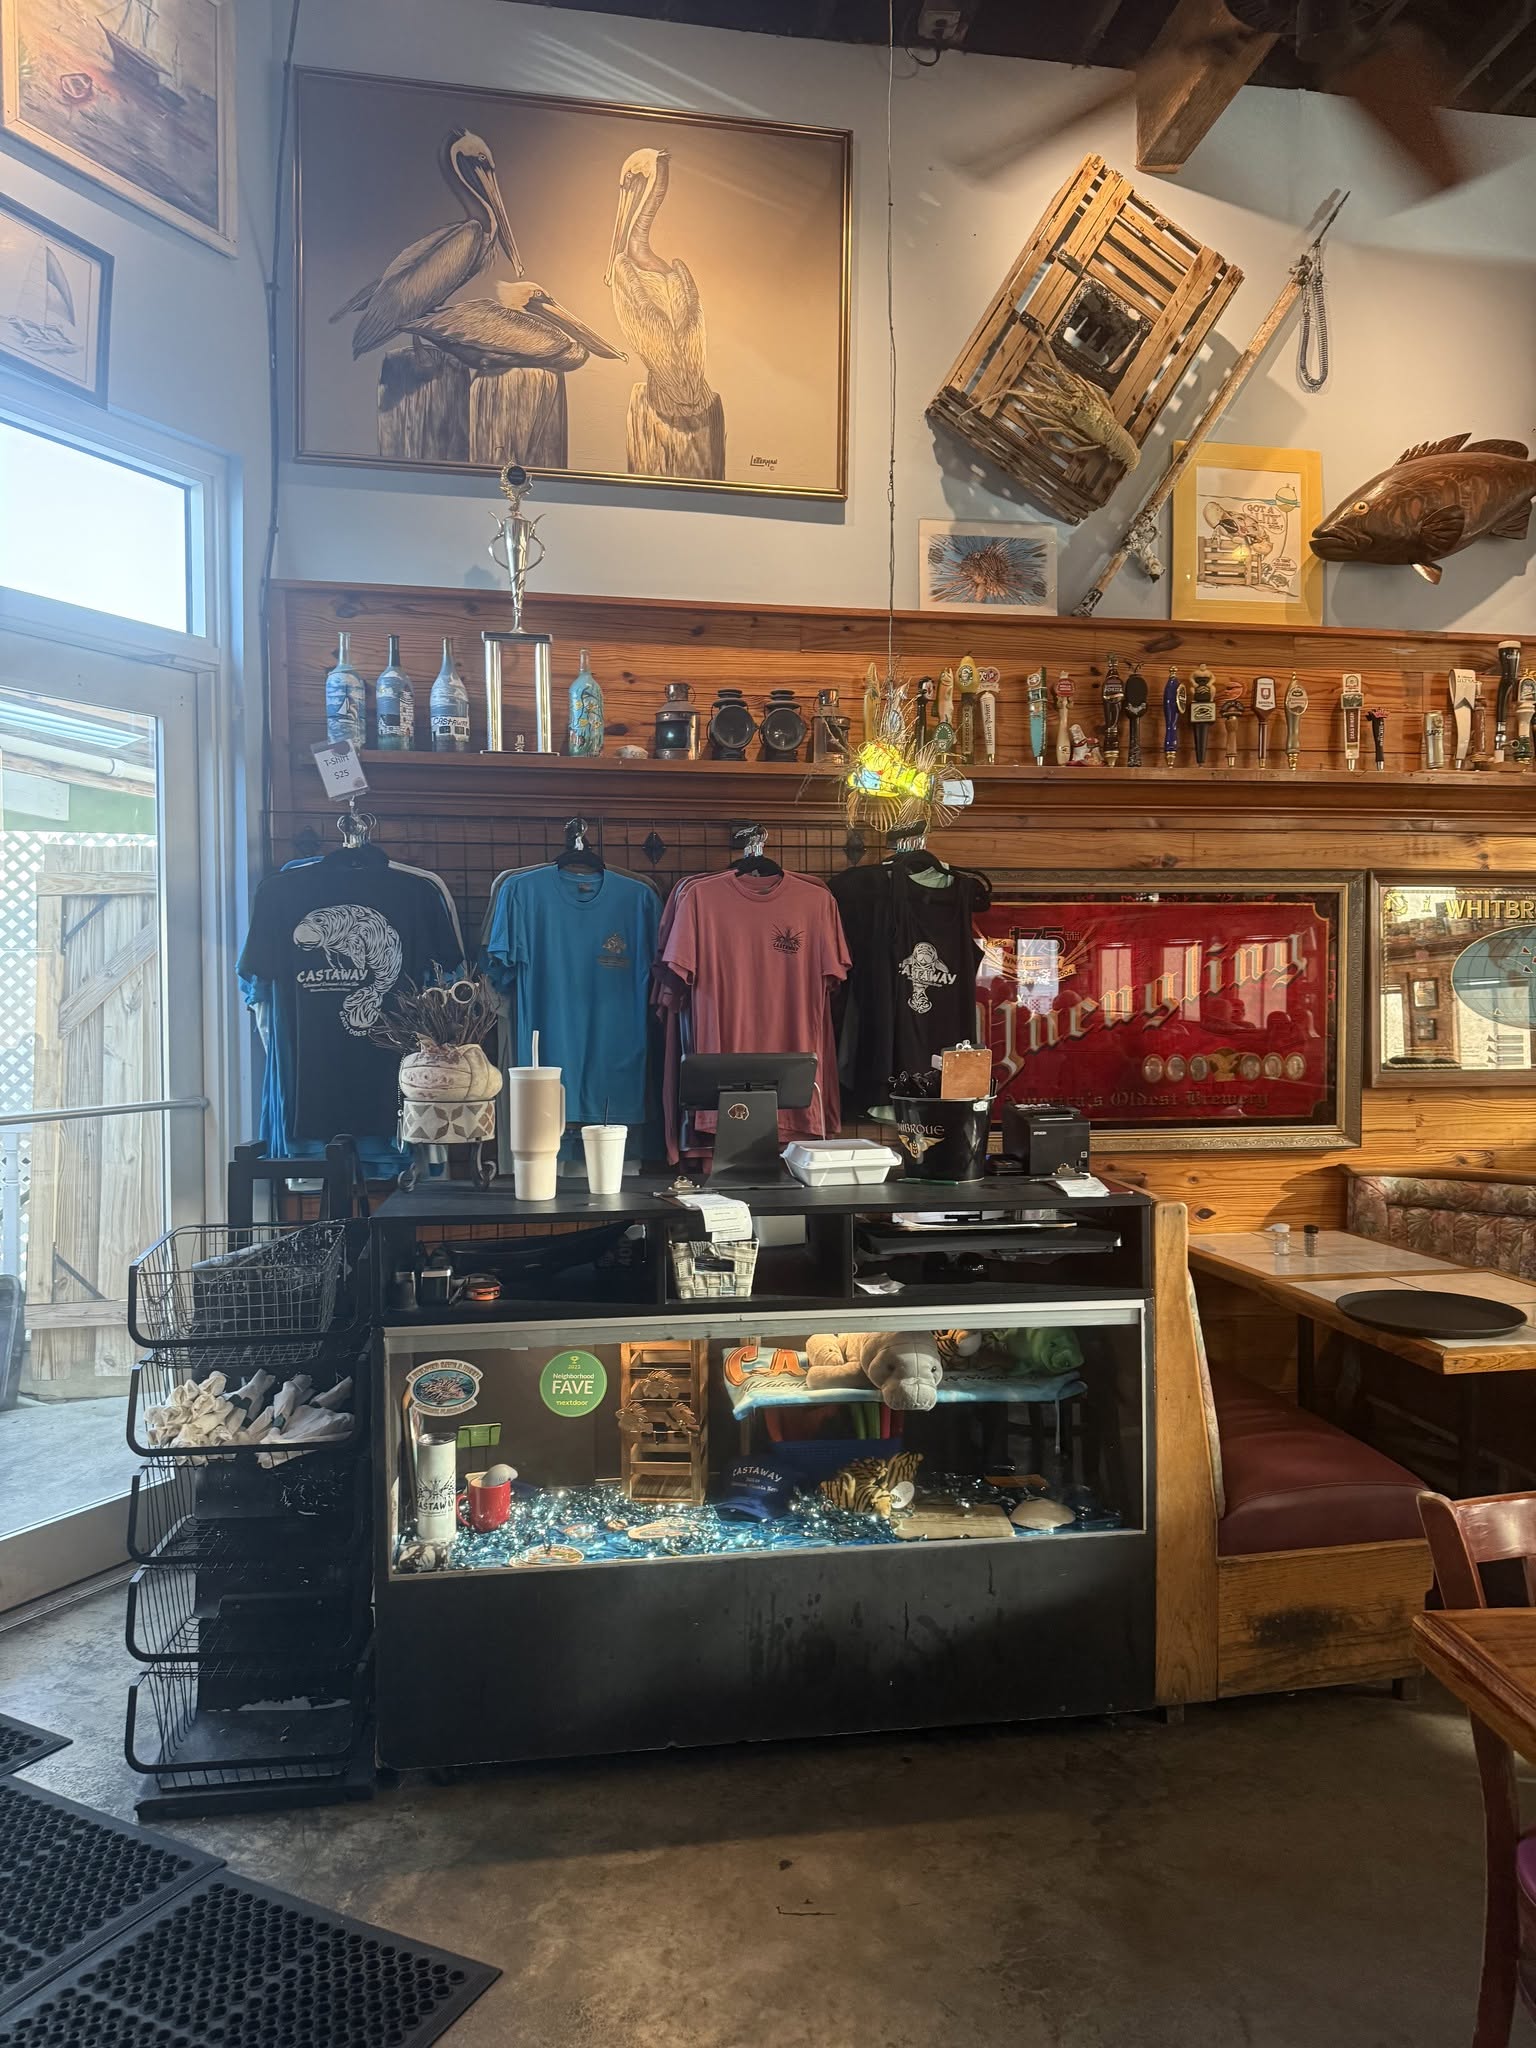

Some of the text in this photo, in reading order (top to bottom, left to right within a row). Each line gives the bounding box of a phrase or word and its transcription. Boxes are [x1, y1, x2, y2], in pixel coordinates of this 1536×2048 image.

[324, 754, 350, 767] T-Shirt
[334, 769, 349, 780] $25
[1446, 899, 1536, 919] WHITBR
[296, 968, 368, 983] CASTAWAY
[552, 1380, 594, 1395] FAVE
[732, 1466, 783, 1482] CASTAWAY
